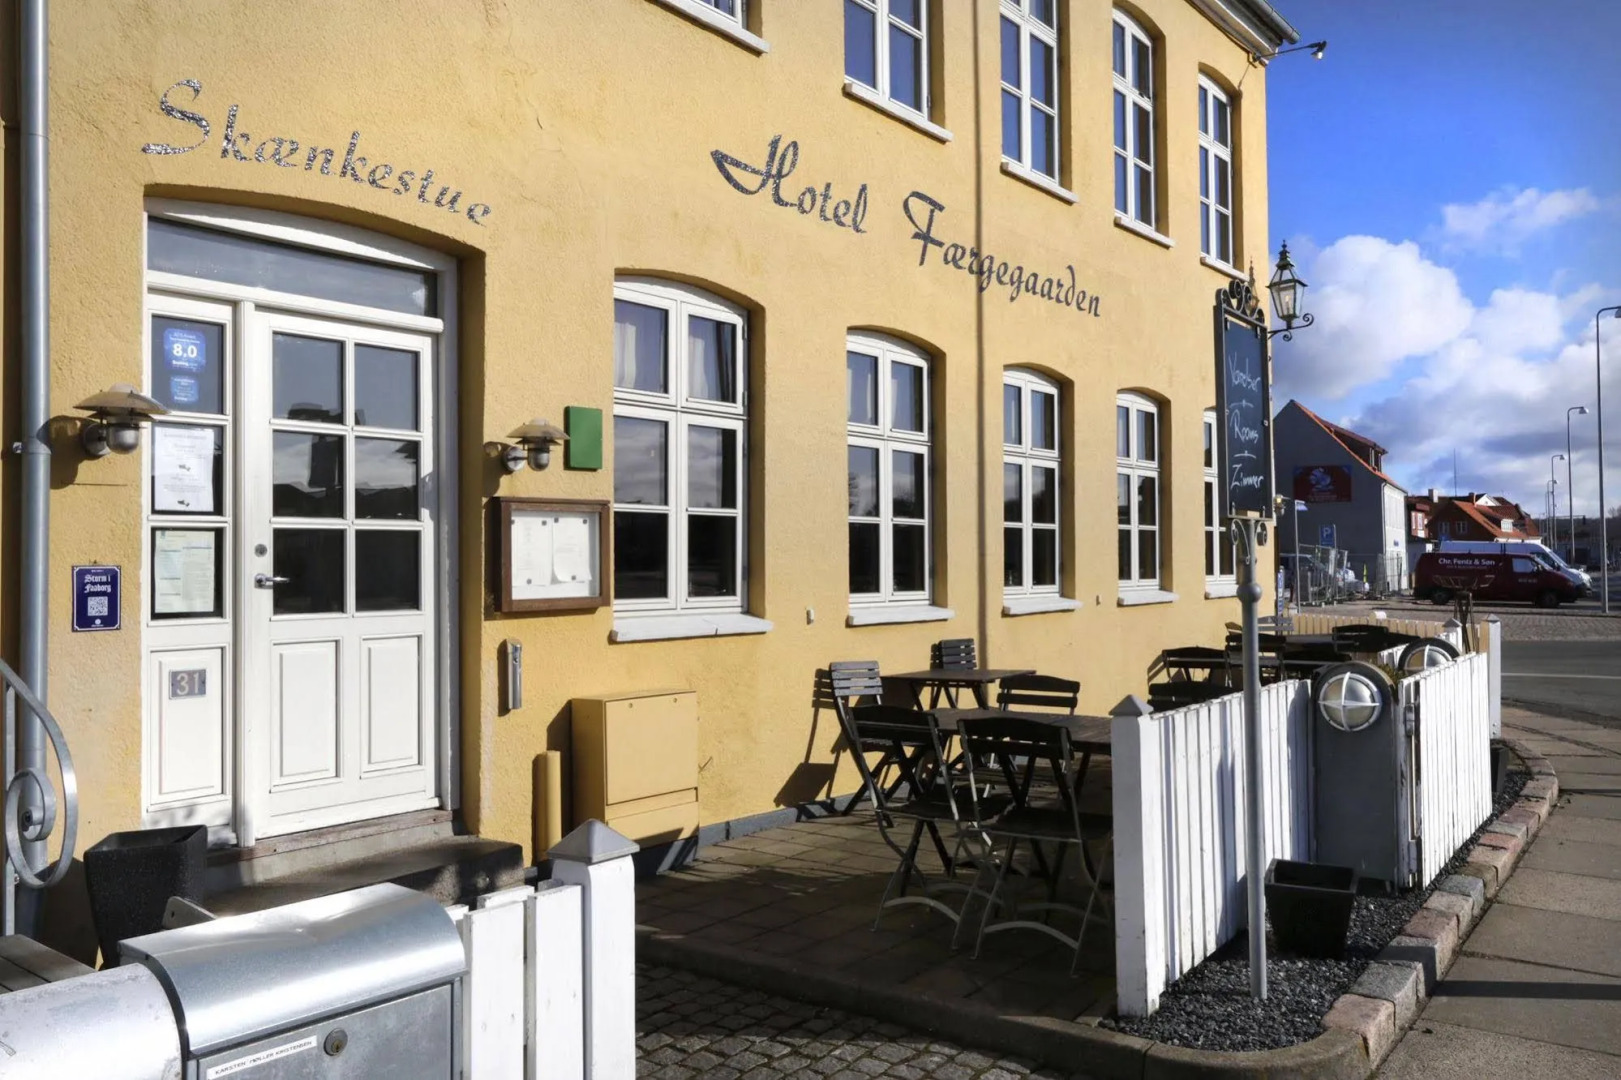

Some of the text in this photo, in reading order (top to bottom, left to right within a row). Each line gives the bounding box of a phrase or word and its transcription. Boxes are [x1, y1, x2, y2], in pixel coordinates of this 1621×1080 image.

[141, 78, 492, 228] Skænkestue
[710, 134, 1101, 317] Hotel Færgegaarden
[1229, 409, 1259, 444] Rooms
[1230, 463, 1264, 490] Zimmer
[1323, 527, 1332, 539] P
[1473, 557, 1480, 565] &
[84, 583, 112, 593] Faaborg
[177, 672, 199, 696] 31
[215, 1061, 246, 1076] KARSTEN
